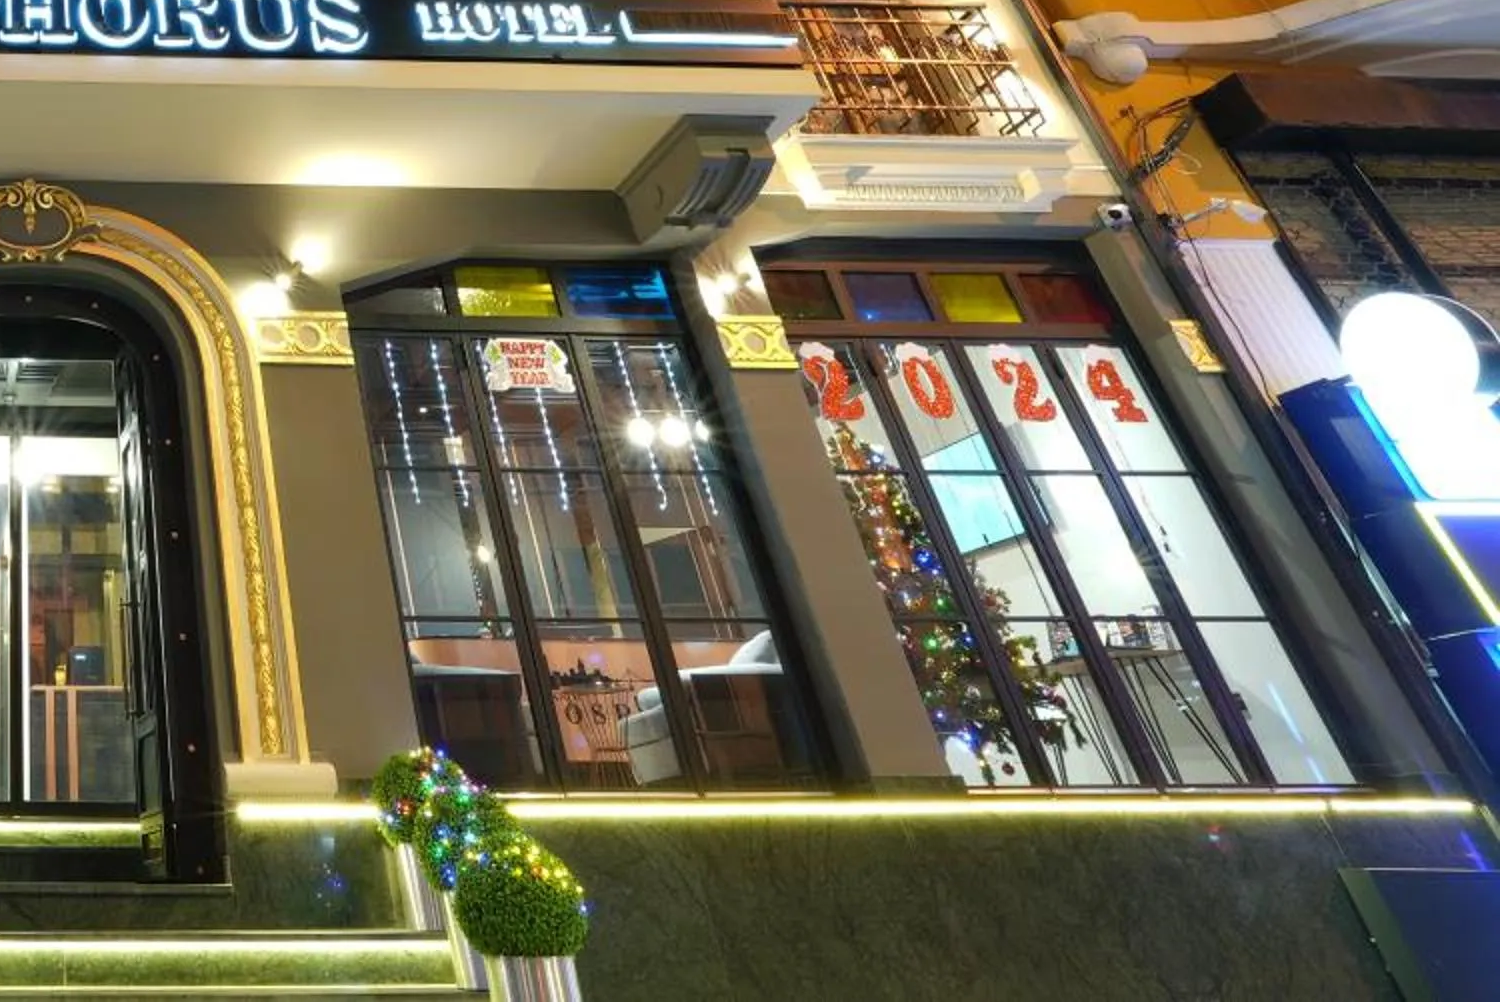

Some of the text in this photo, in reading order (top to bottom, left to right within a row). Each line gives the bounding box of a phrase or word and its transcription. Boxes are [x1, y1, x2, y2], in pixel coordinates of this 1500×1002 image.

[414, 1, 618, 44] HOTEL
[500, 341, 547, 355] HAPPY
[508, 357, 545, 369] NEW
[510, 371, 549, 385] YEAR
